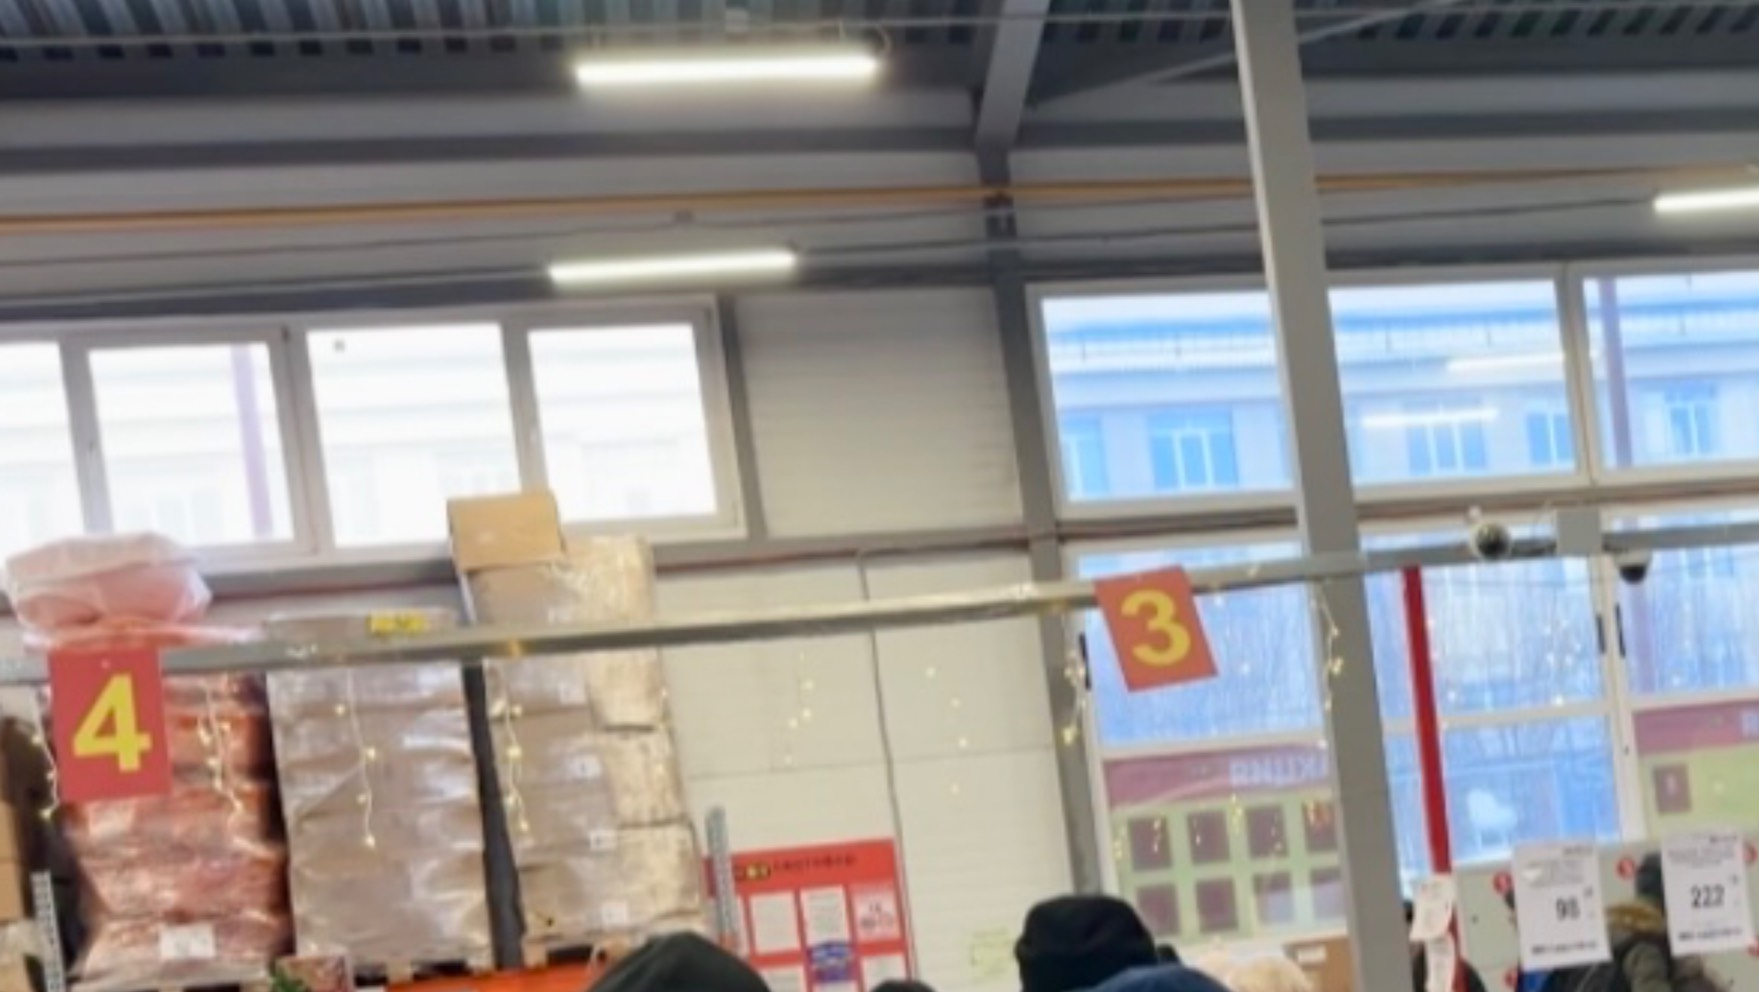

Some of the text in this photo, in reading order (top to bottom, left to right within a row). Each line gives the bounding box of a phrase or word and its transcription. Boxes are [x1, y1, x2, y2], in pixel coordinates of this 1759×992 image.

[1122, 590, 1192, 668] 3
[74, 675, 152, 772] 4
[1690, 883, 1725, 909] 222
